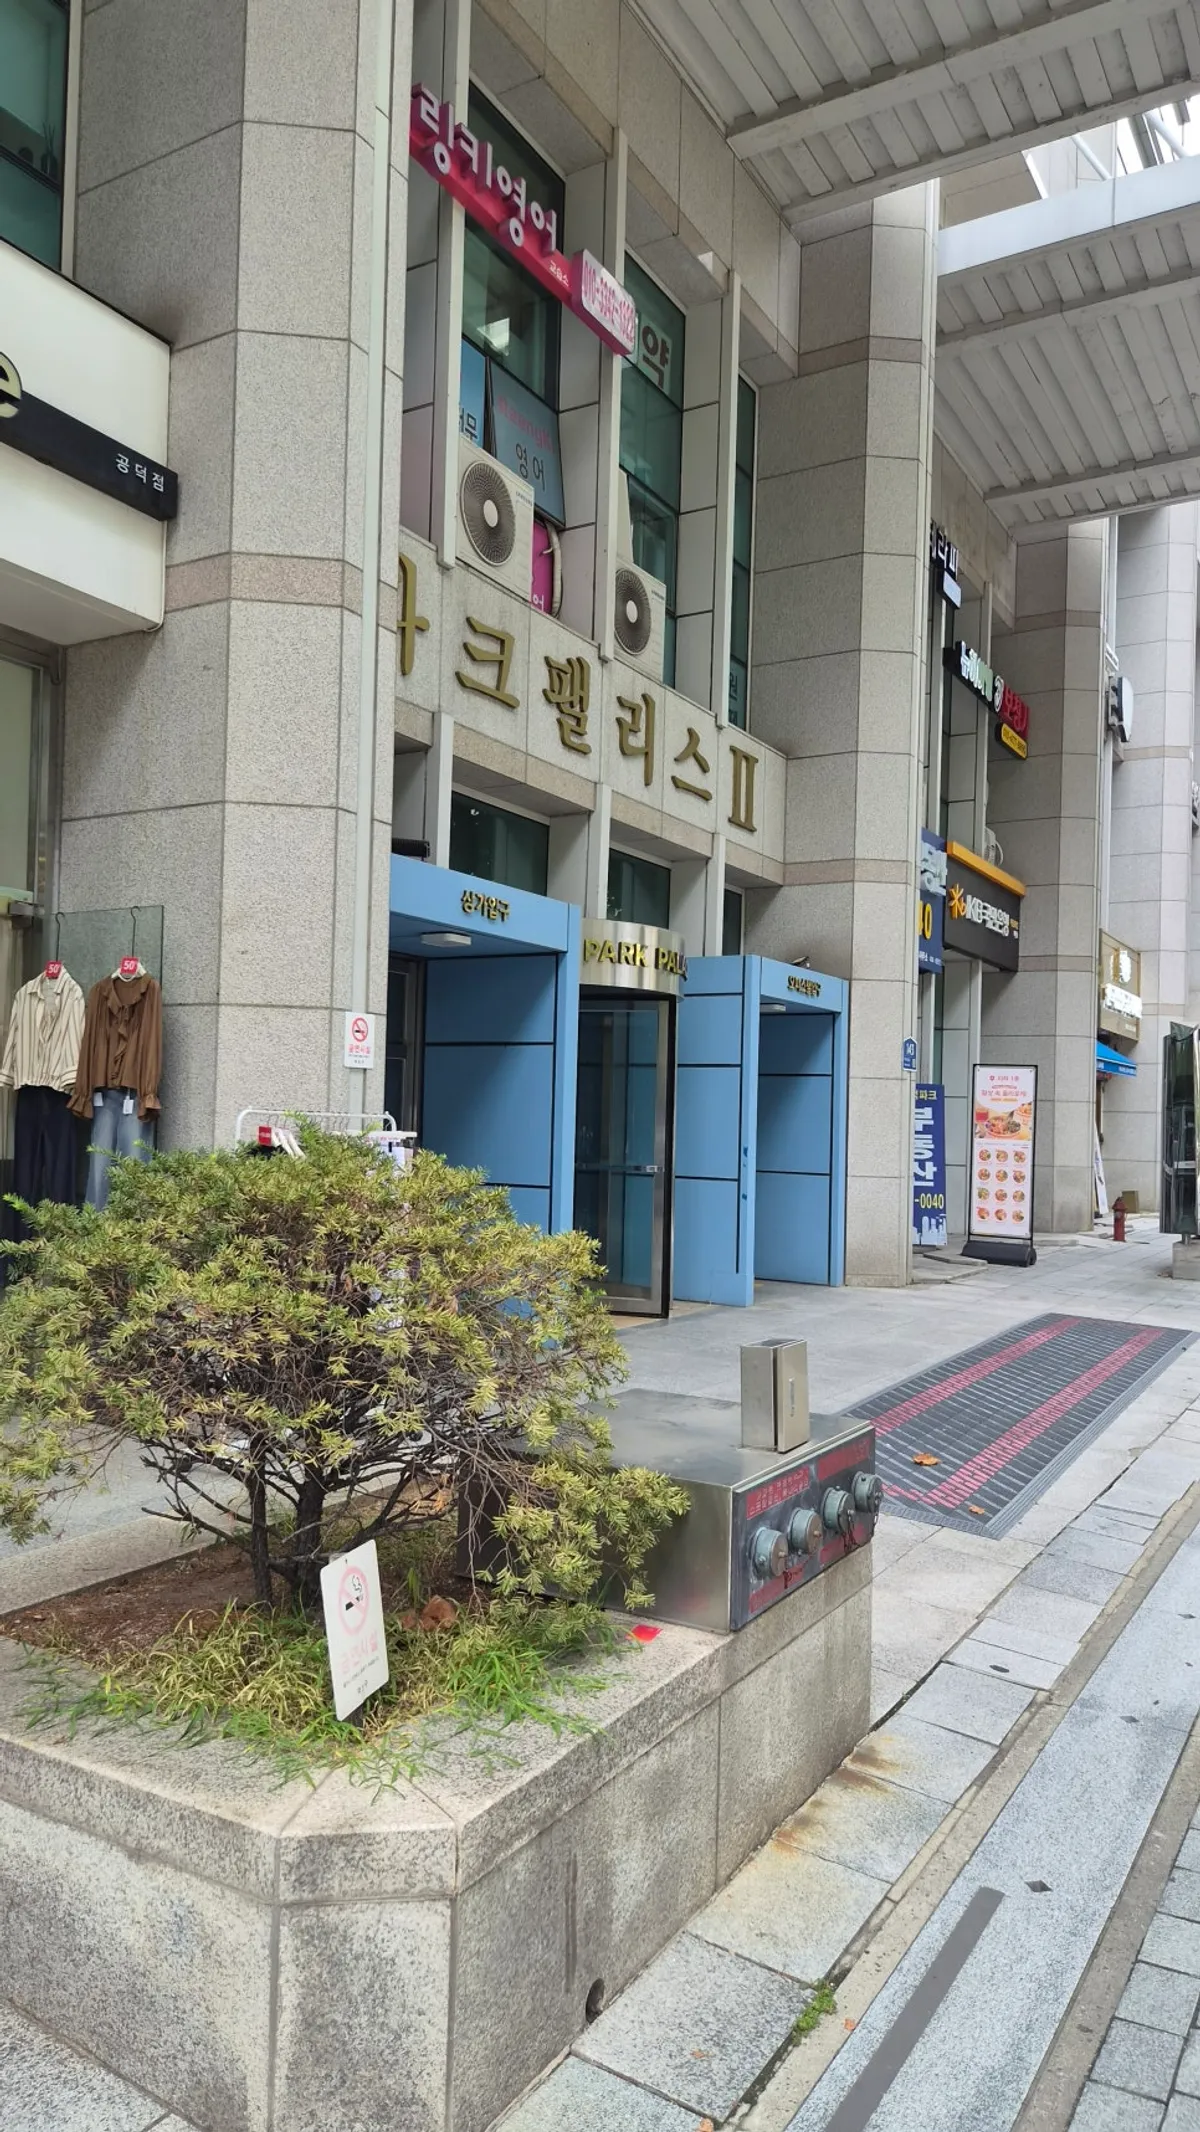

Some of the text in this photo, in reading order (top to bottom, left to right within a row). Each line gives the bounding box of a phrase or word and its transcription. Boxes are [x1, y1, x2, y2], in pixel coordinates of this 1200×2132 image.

[414, 86, 558, 254] 링키영어
[641, 325, 671, 390] 약
[115, 453, 165, 493] 공덕점
[515, 442, 546, 492] 영어
[461, 889, 511, 923] 상가입구
[583, 938, 649, 968] PARK
